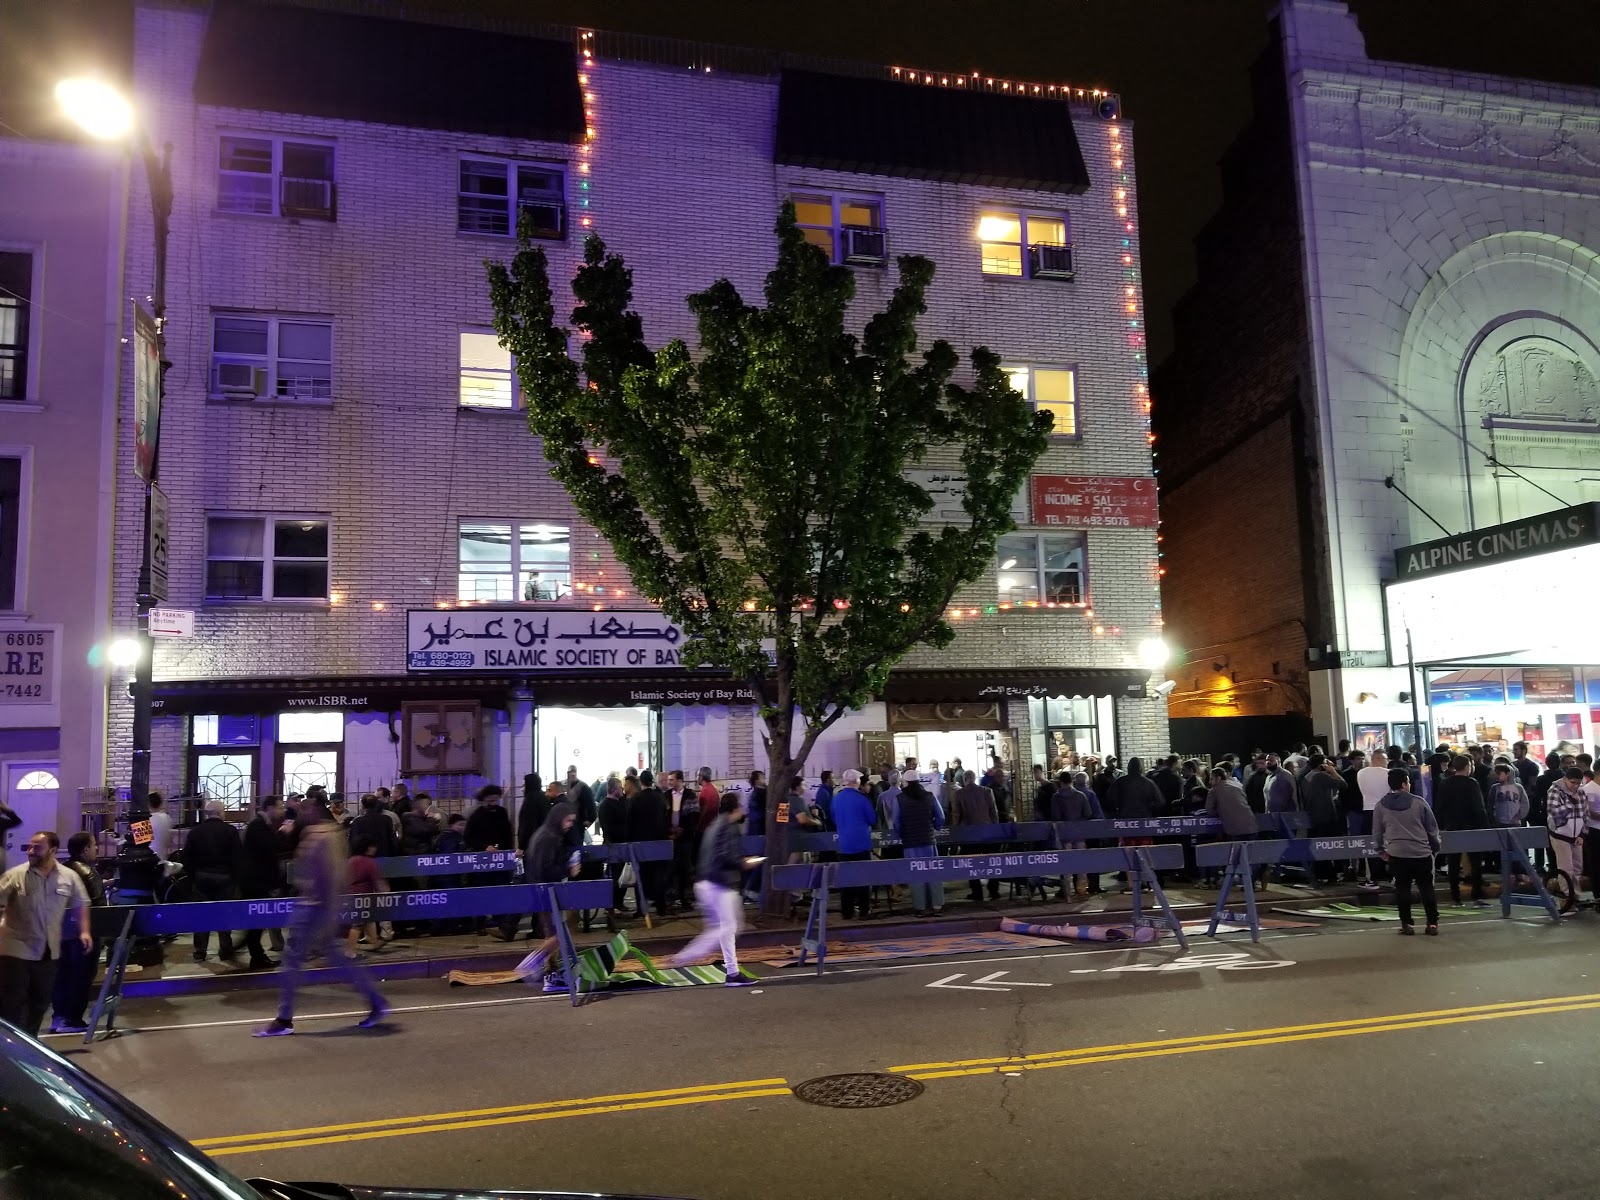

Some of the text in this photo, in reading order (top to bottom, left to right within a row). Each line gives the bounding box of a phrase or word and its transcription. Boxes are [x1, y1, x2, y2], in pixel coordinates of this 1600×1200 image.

[1045, 494, 1083, 506] INCOME
[1083, 516, 1129, 525] 492-5076
[154, 532, 166, 567] 25
[1407, 516, 1581, 573] ALPINE CINEMAS
[514, 617, 549, 648] بن
[7, 633, 44, 646] 6805
[412, 651, 471, 660] Tel. 680-0121
[484, 649, 682, 666] ISLAMIC SOCIETY OF BAY
[0, 651, 44, 676] RE
[412, 659, 471, 667] Fax 439-4992
[630, 688, 756, 701] Islamic Society of Bay Rid
[287, 695, 368, 707] www.ISBR.net
[1114, 820, 1139, 829] POLICE
[1144, 819, 1160, 828] LINE
[1171, 819, 1181, 827] DO
[1182, 818, 1197, 826] NOT
[1316, 840, 1344, 850] POLICE
[1347, 839, 1366, 848] LINE
[417, 855, 450, 866] POLICE
[457, 854, 478, 864] LINE
[492, 852, 504, 862] DO
[910, 859, 944, 871] POLICE
[952, 858, 974, 869] LINE
[989, 856, 1002, 867] DO
[1005, 855, 1024, 866] NOT
[1027, 853, 1059, 865] CROSS
[473, 862, 504, 870] NYPD
[969, 868, 1002, 877] NYPD
[248, 901, 294, 915] POLICE
[354, 897, 371, 909] DO
[376, 895, 402, 908] NOT
[407, 893, 447, 906] CROSS
[339, 910, 370, 920] YPD
